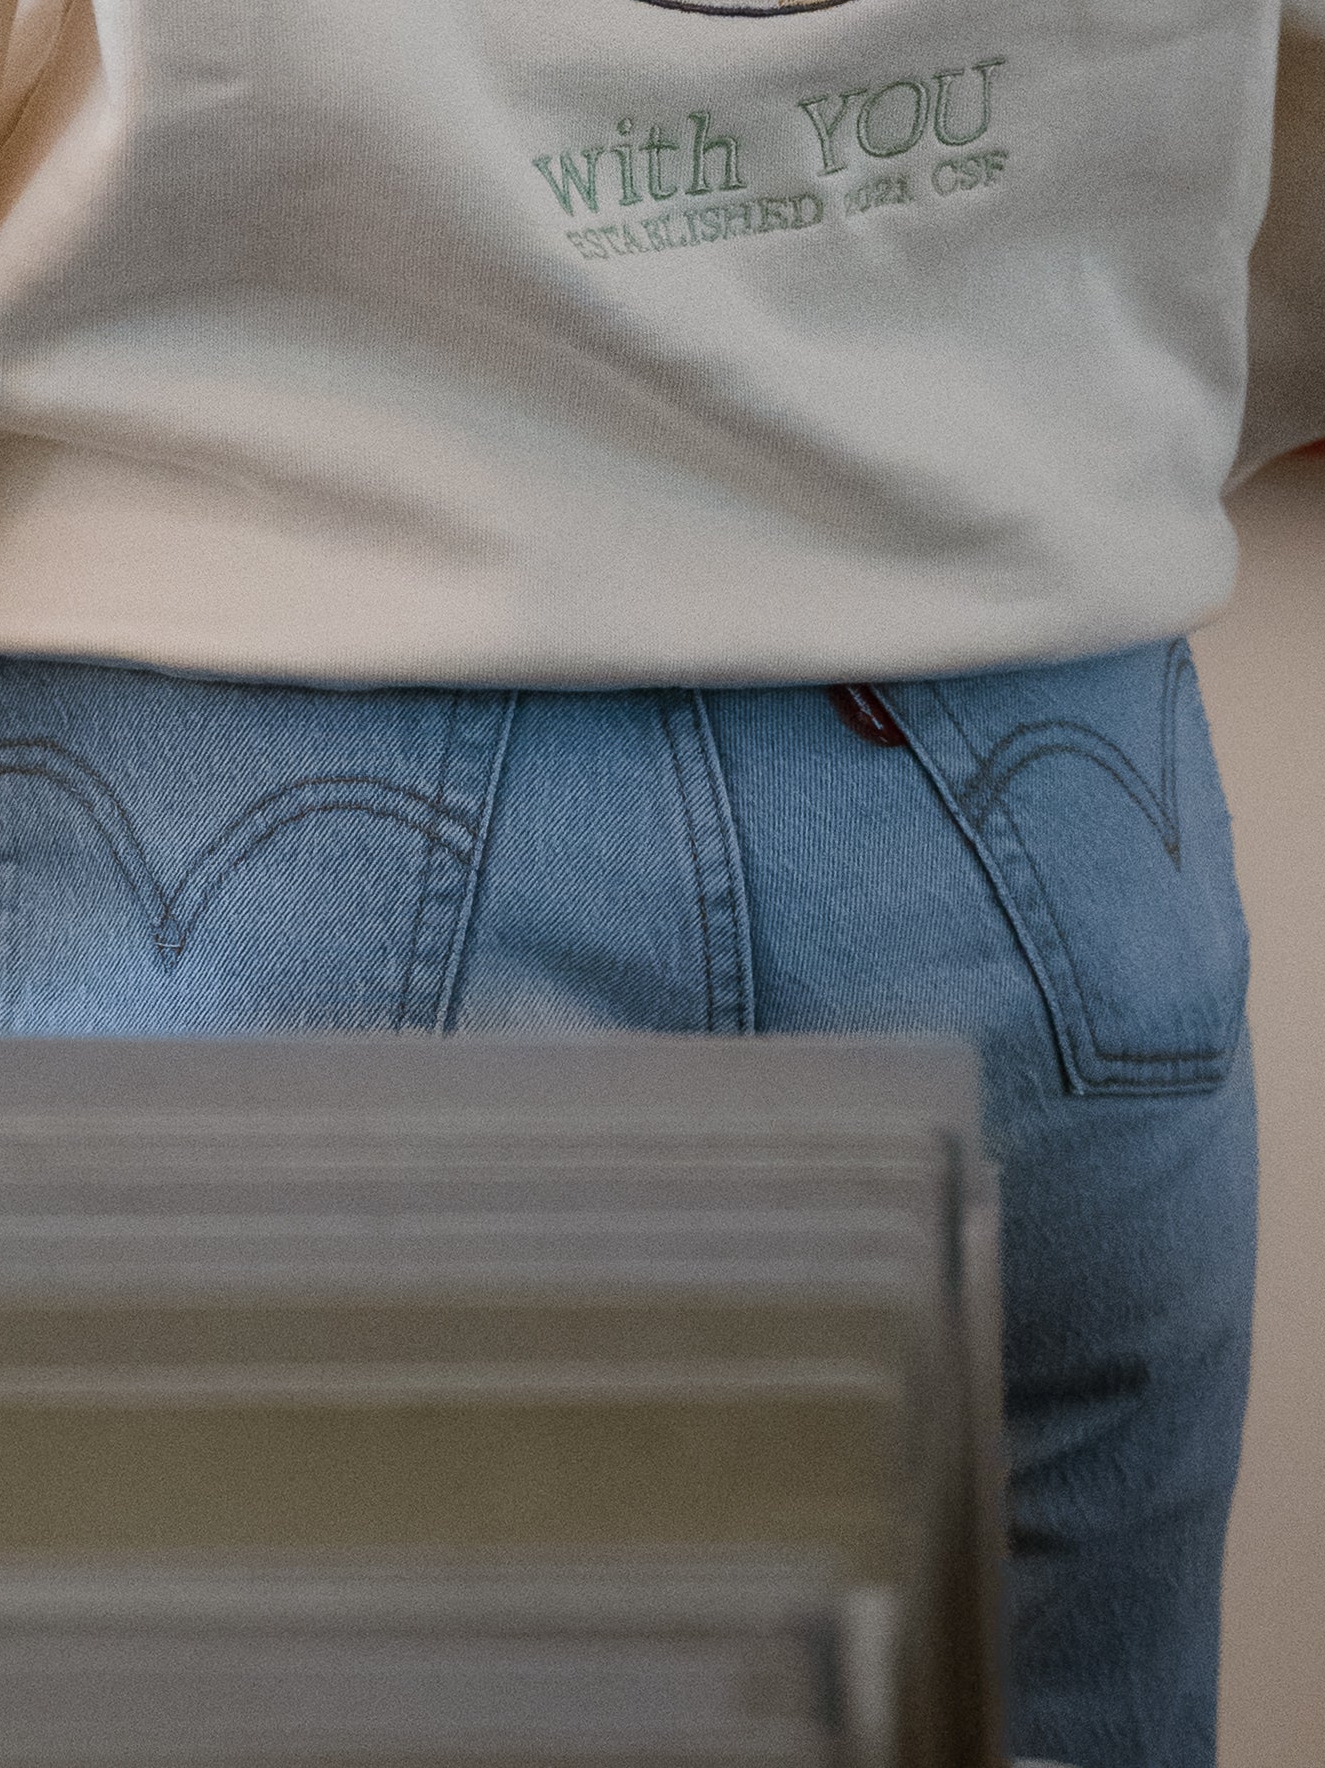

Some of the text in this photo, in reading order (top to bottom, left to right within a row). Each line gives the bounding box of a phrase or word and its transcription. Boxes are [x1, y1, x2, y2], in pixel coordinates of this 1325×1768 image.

[531, 57, 1007, 217] with YOU
[566, 191, 826, 261] ESTABLISHED
[930, 149, 1009, 198] CSF
